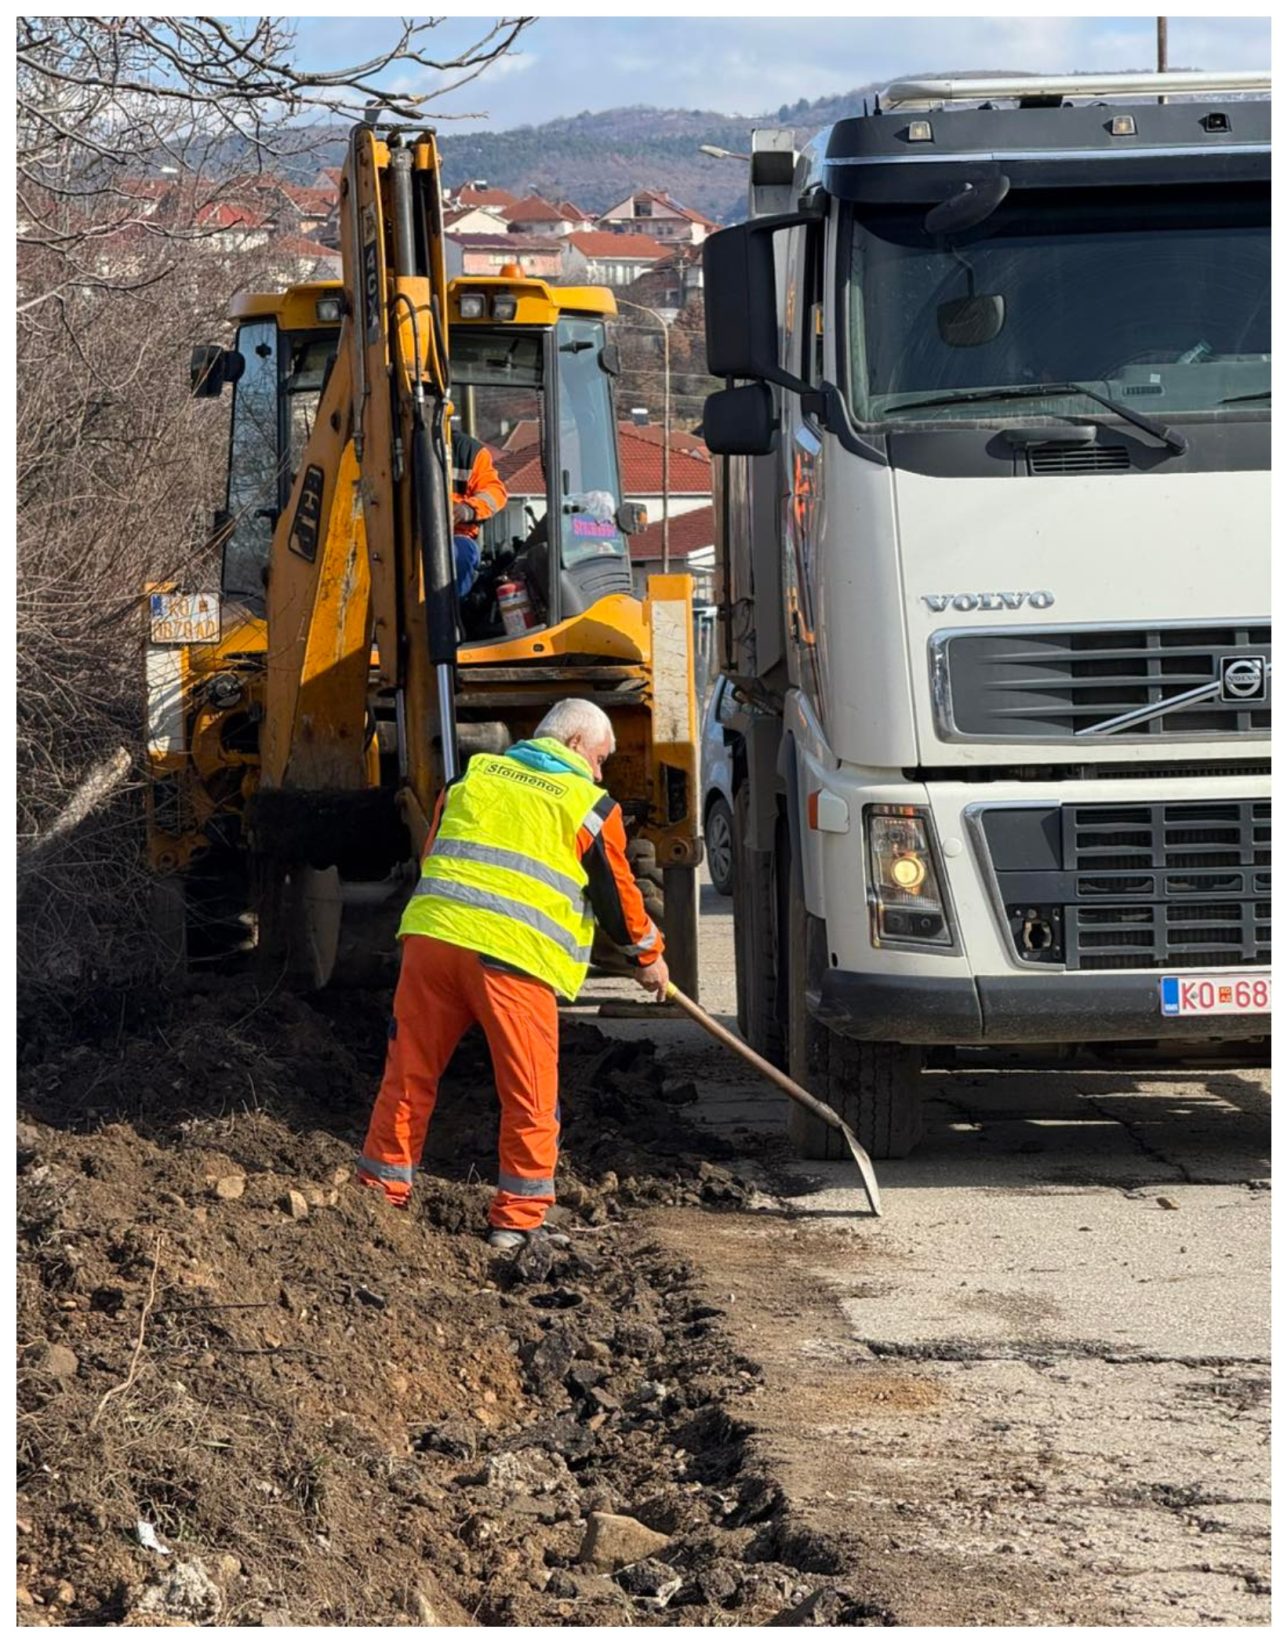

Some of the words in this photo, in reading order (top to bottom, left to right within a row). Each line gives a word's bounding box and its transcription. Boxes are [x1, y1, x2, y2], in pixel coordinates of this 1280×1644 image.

[920, 591, 1055, 612] VOLVO
[487, 763, 564, 796] Stoimenov
[1182, 982, 1214, 1009] KO
[1236, 981, 1268, 1007] 68
